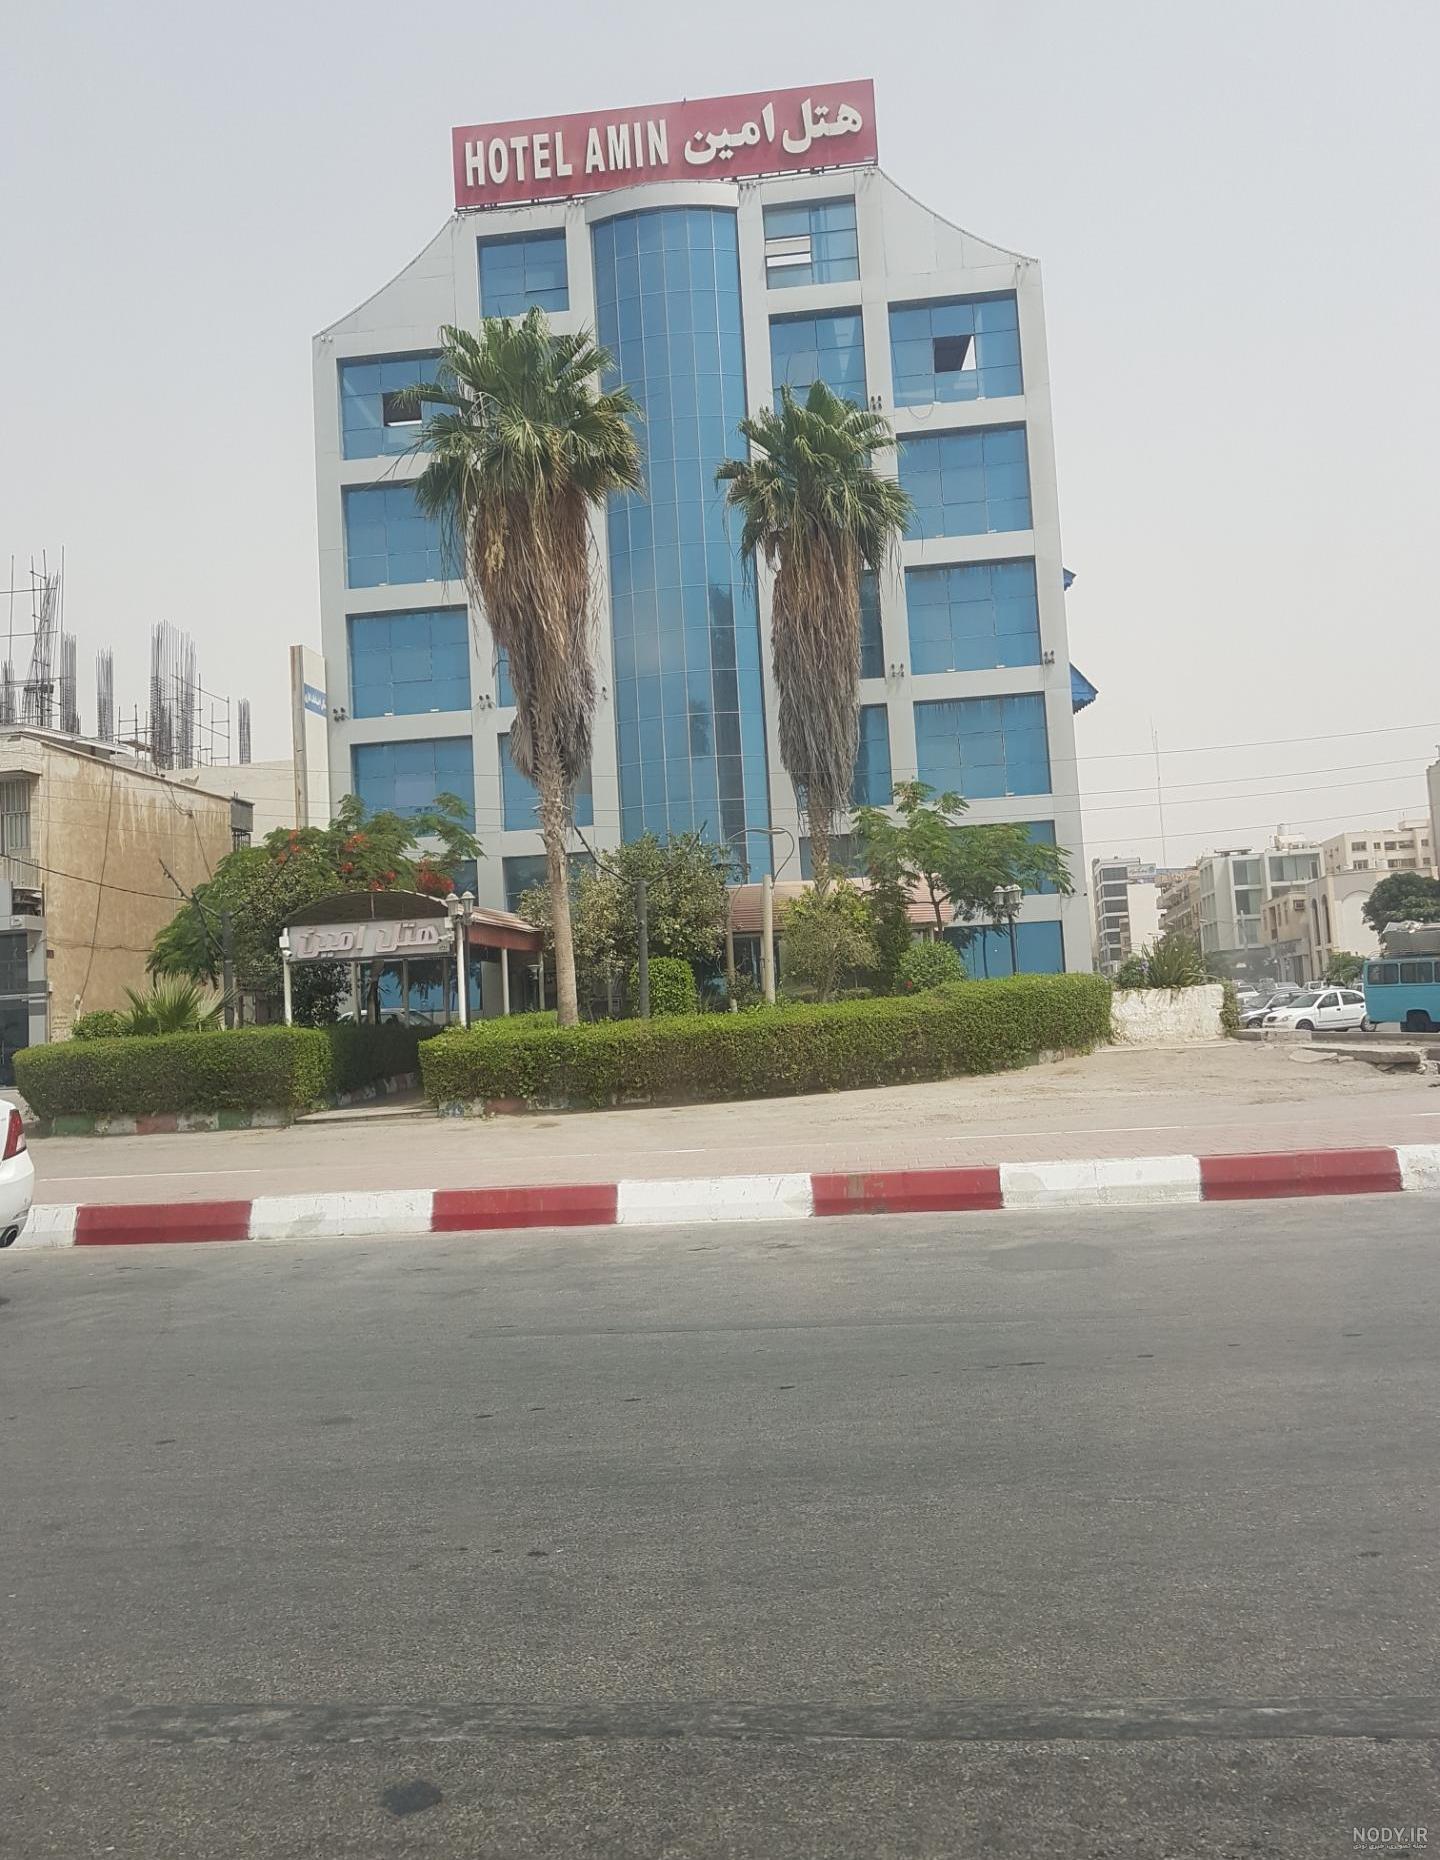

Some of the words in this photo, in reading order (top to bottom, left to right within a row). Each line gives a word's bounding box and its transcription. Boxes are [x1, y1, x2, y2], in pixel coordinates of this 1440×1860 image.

[464, 131, 573, 187] HOTEL
[585, 119, 670, 174] AMIN
[684, 102, 776, 165] امین
[782, 98, 864, 154] هتل
[296, 924, 368, 959] امین
[375, 920, 440, 953] هتل
